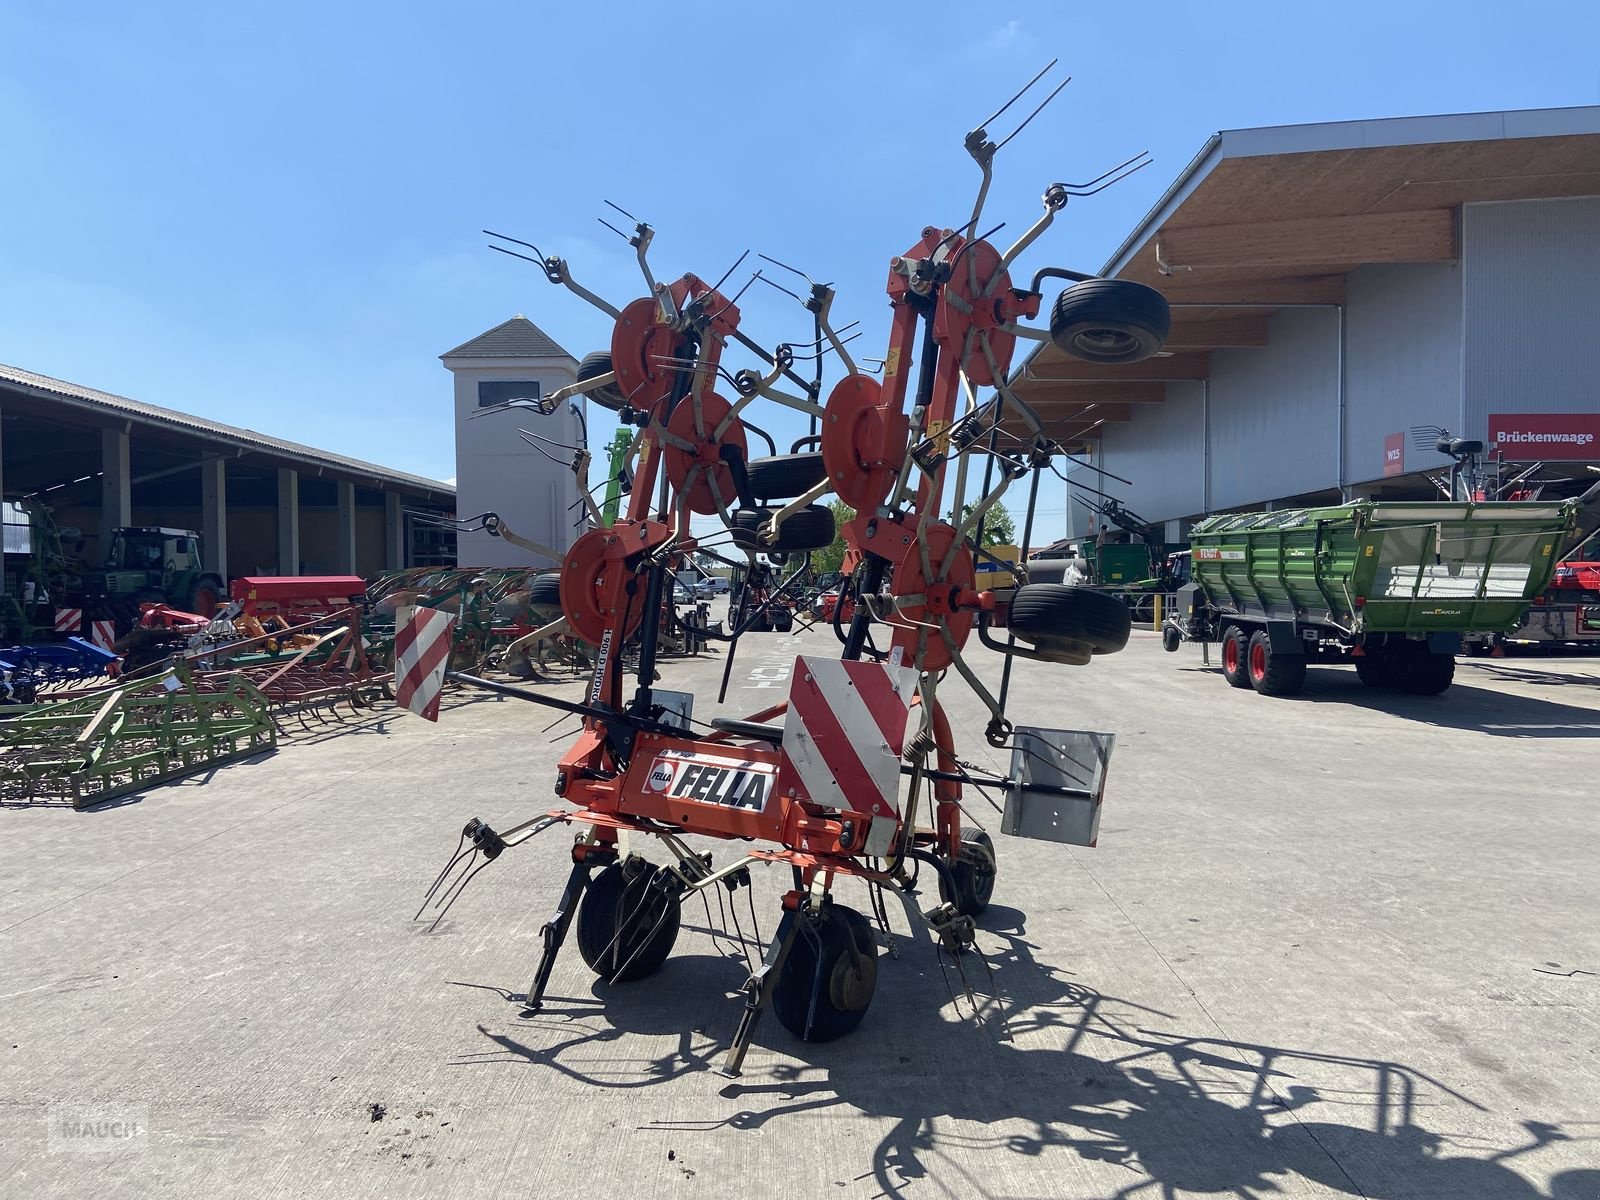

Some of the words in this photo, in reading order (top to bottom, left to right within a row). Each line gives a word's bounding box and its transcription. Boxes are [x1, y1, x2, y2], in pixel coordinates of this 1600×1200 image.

[1497, 430, 1594, 445] Brückenwaage
[1387, 449, 1400, 461] W15
[601, 637, 610, 655] 900
[592, 668, 604, 701] HYDRO
[651, 771, 672, 783] FELLA
[672, 764, 766, 810] FELLA
